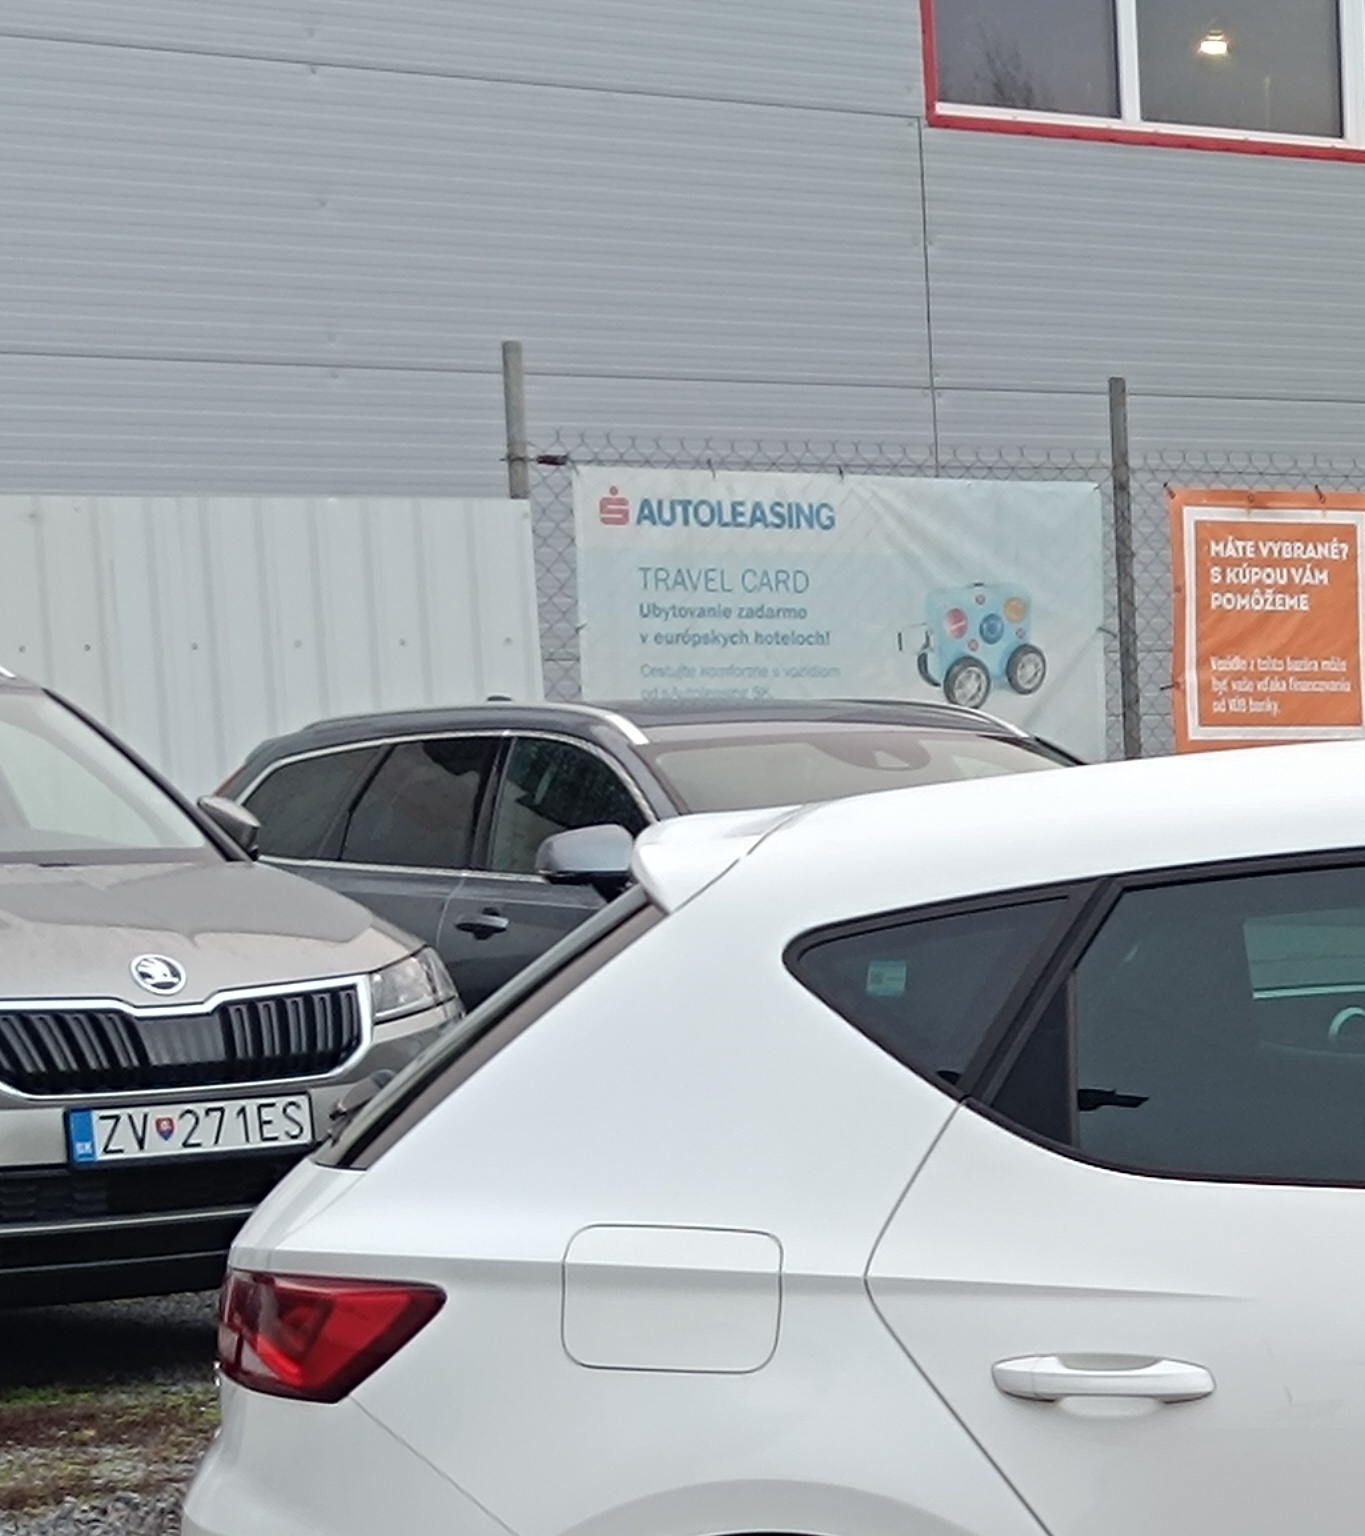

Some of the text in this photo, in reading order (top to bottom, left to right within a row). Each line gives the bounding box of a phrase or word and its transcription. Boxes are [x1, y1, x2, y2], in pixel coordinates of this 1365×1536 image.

[636, 498, 836, 531] AUTOLEASING
[1209, 536, 1349, 560] MÁTE VYBRANÉ?
[639, 567, 810, 594] TRAVEL CARD
[1209, 562, 1329, 585] S KÚPOU VÁM
[1210, 588, 1310, 611] POMÔŽEME
[639, 603, 808, 621] Ubytovanie zadarmo
[653, 629, 749, 648] európskych
[754, 630, 831, 646] hoteloch!
[99, 1113, 148, 1154] ZV
[179, 1101, 304, 1148] 271ES
